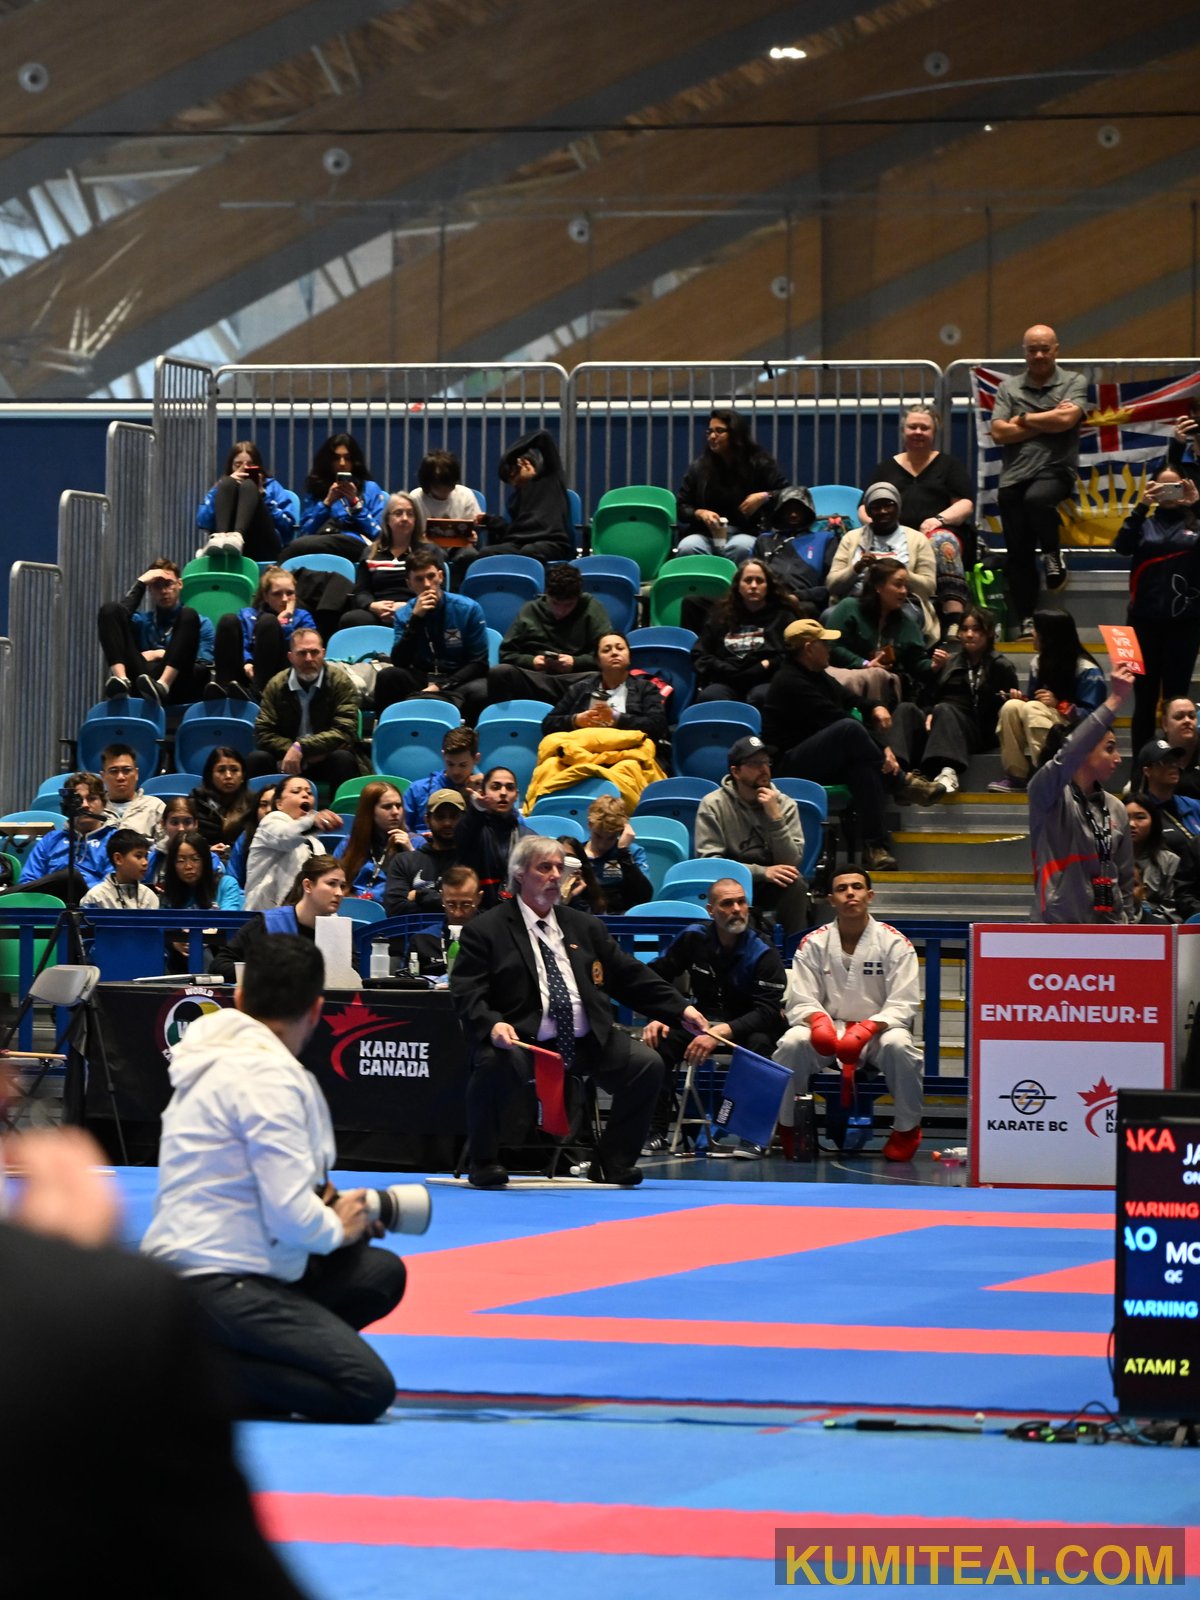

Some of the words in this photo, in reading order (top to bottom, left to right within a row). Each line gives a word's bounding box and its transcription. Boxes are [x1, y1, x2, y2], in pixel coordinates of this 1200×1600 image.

[184, 987, 214, 997] WORLD
[1028, 973, 1116, 992] COACH
[980, 1000, 1159, 1024] ENTRAÎNEUR·E
[359, 1040, 430, 1059] KARATE
[359, 1059, 430, 1078] CANADA
[987, 1119, 1045, 1131] KARATE
[1048, 1121, 1068, 1132] BC
[1164, 1269, 1183, 1284] QC
[1124, 1357, 1176, 1375] ATAMI
[1179, 1359, 1190, 1376] 2
